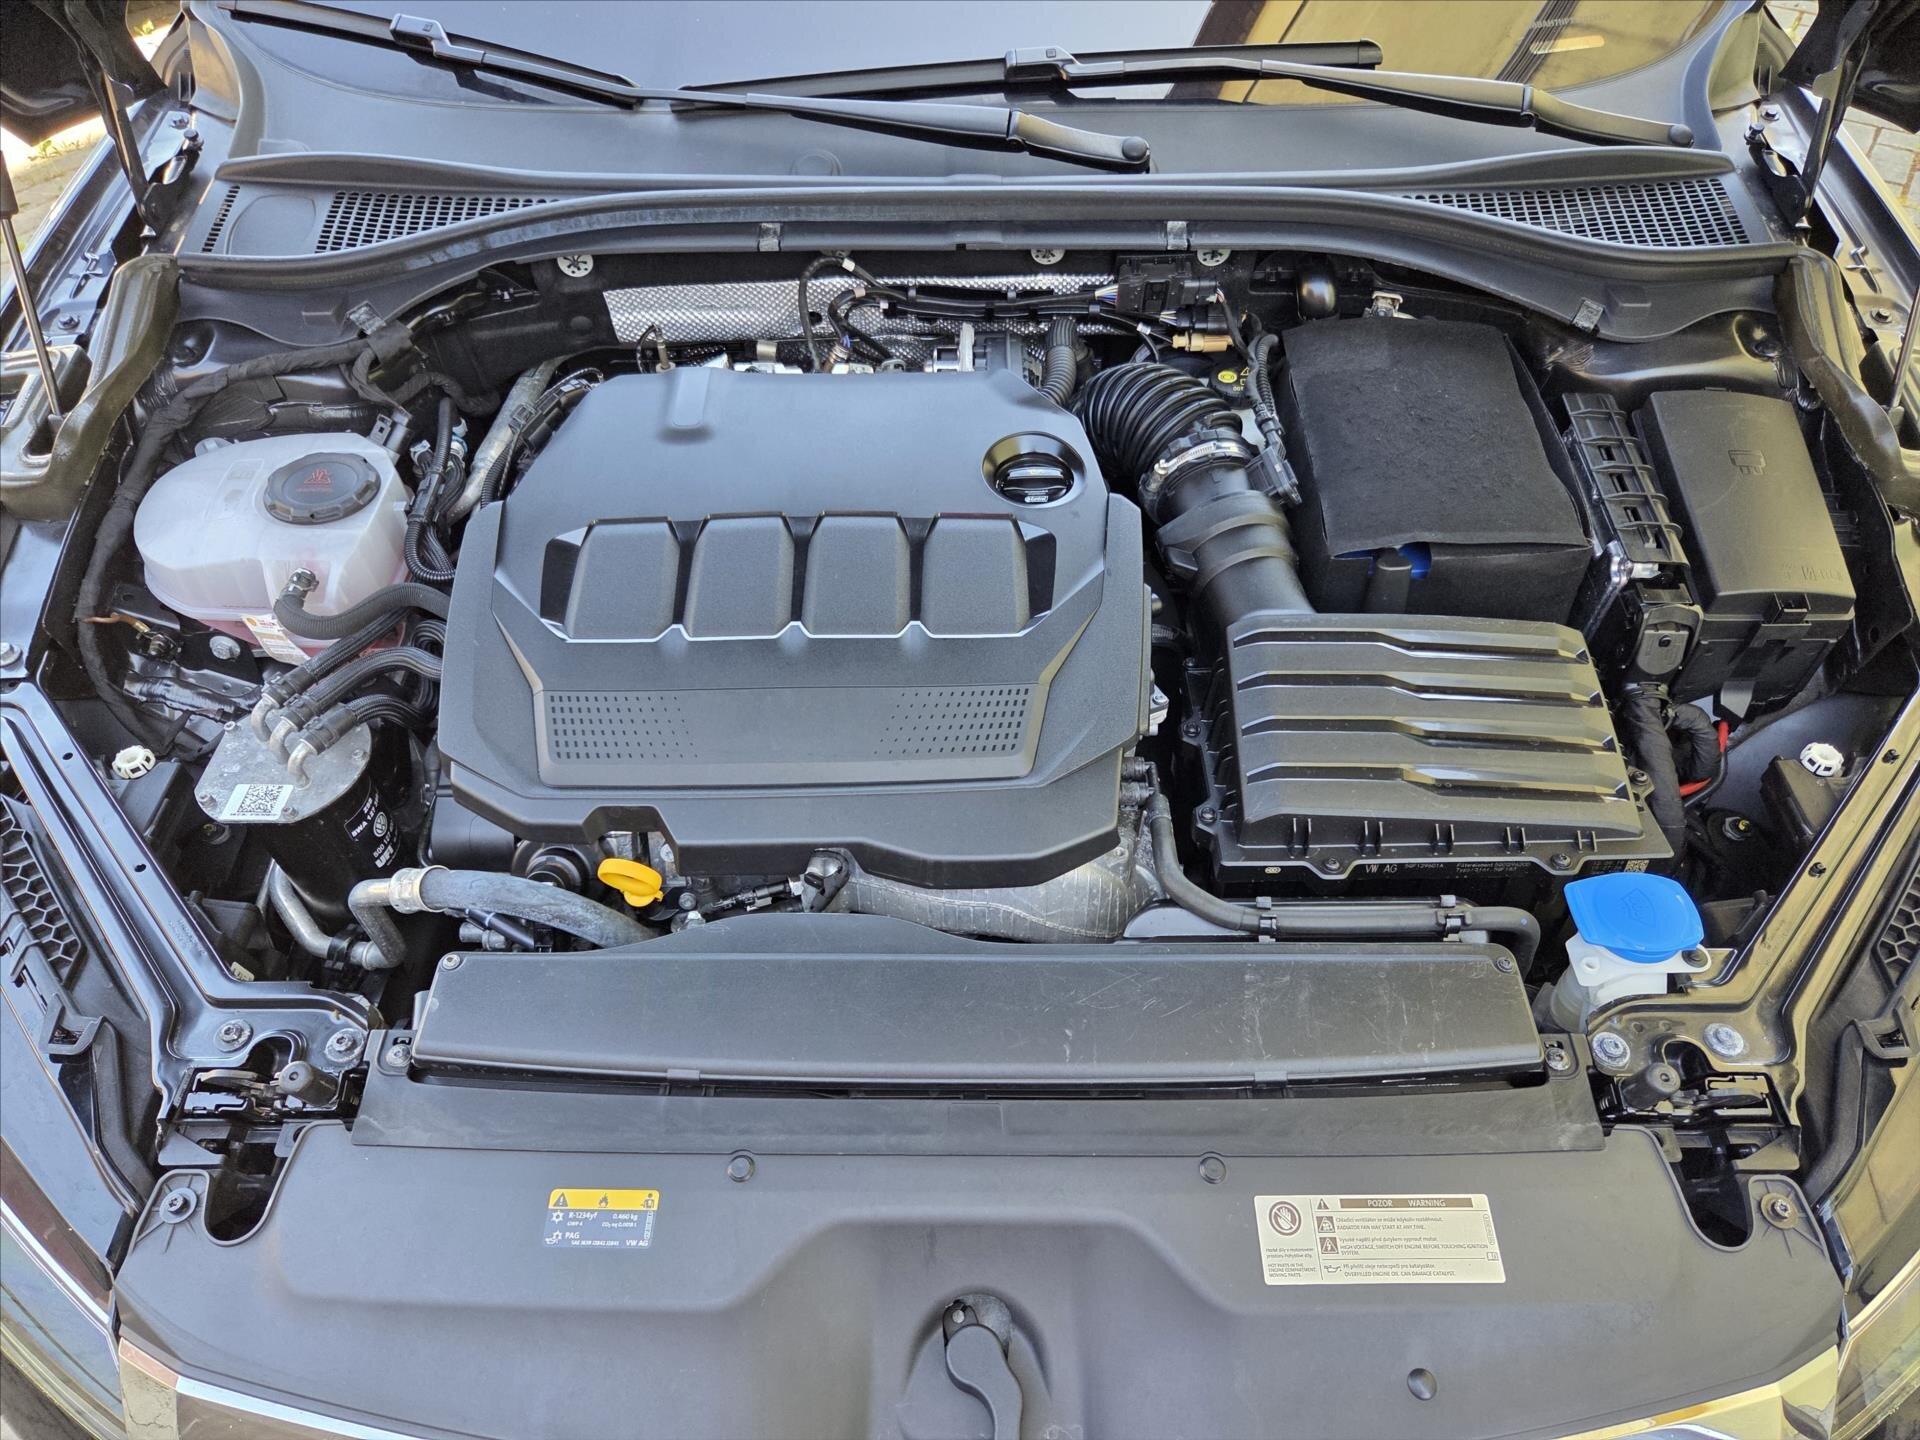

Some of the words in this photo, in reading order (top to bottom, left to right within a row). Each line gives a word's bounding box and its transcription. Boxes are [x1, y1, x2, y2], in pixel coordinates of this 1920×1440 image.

[374, 845, 394, 868] UFI
[1365, 864, 1380, 873] VW
[1383, 864, 1398, 873] AG
[1367, 1199, 1393, 1207] POZOR
[1407, 1199, 1446, 1207] WARNING
[568, 1211, 598, 1220] R-1234yf
[630, 1213, 638, 1221] kg
